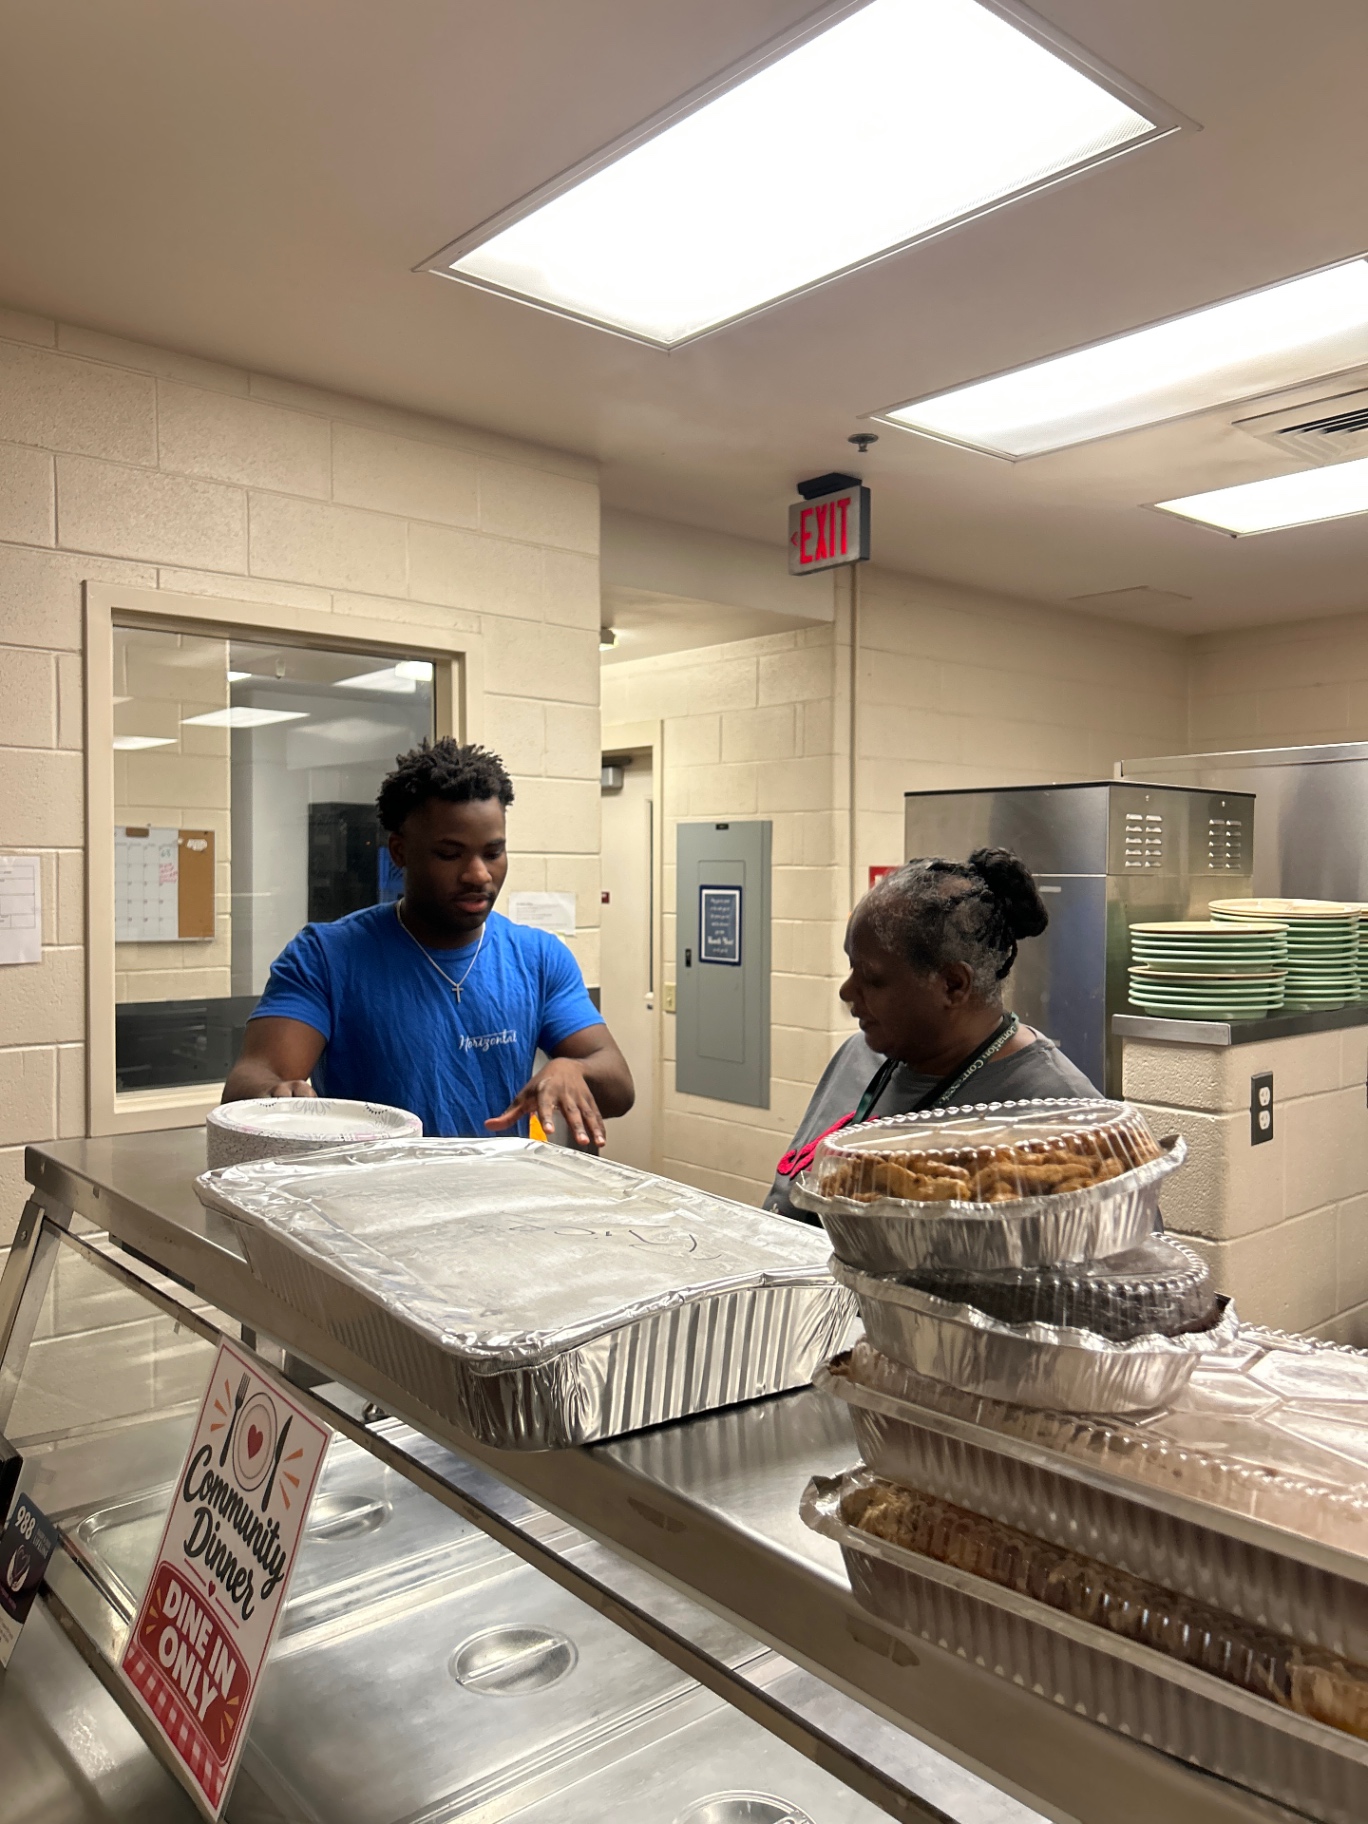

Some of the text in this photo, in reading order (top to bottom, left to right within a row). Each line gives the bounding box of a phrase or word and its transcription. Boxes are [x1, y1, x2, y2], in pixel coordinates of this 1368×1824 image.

[800, 497, 851, 565] EXIT
[15, 1505, 36, 1540] 988
[183, 1444, 287, 1600] Community
[183, 1506, 255, 1620] Dinner
[158, 1625, 218, 1722] ONLY
[162, 1579, 237, 1700] DINE IN
